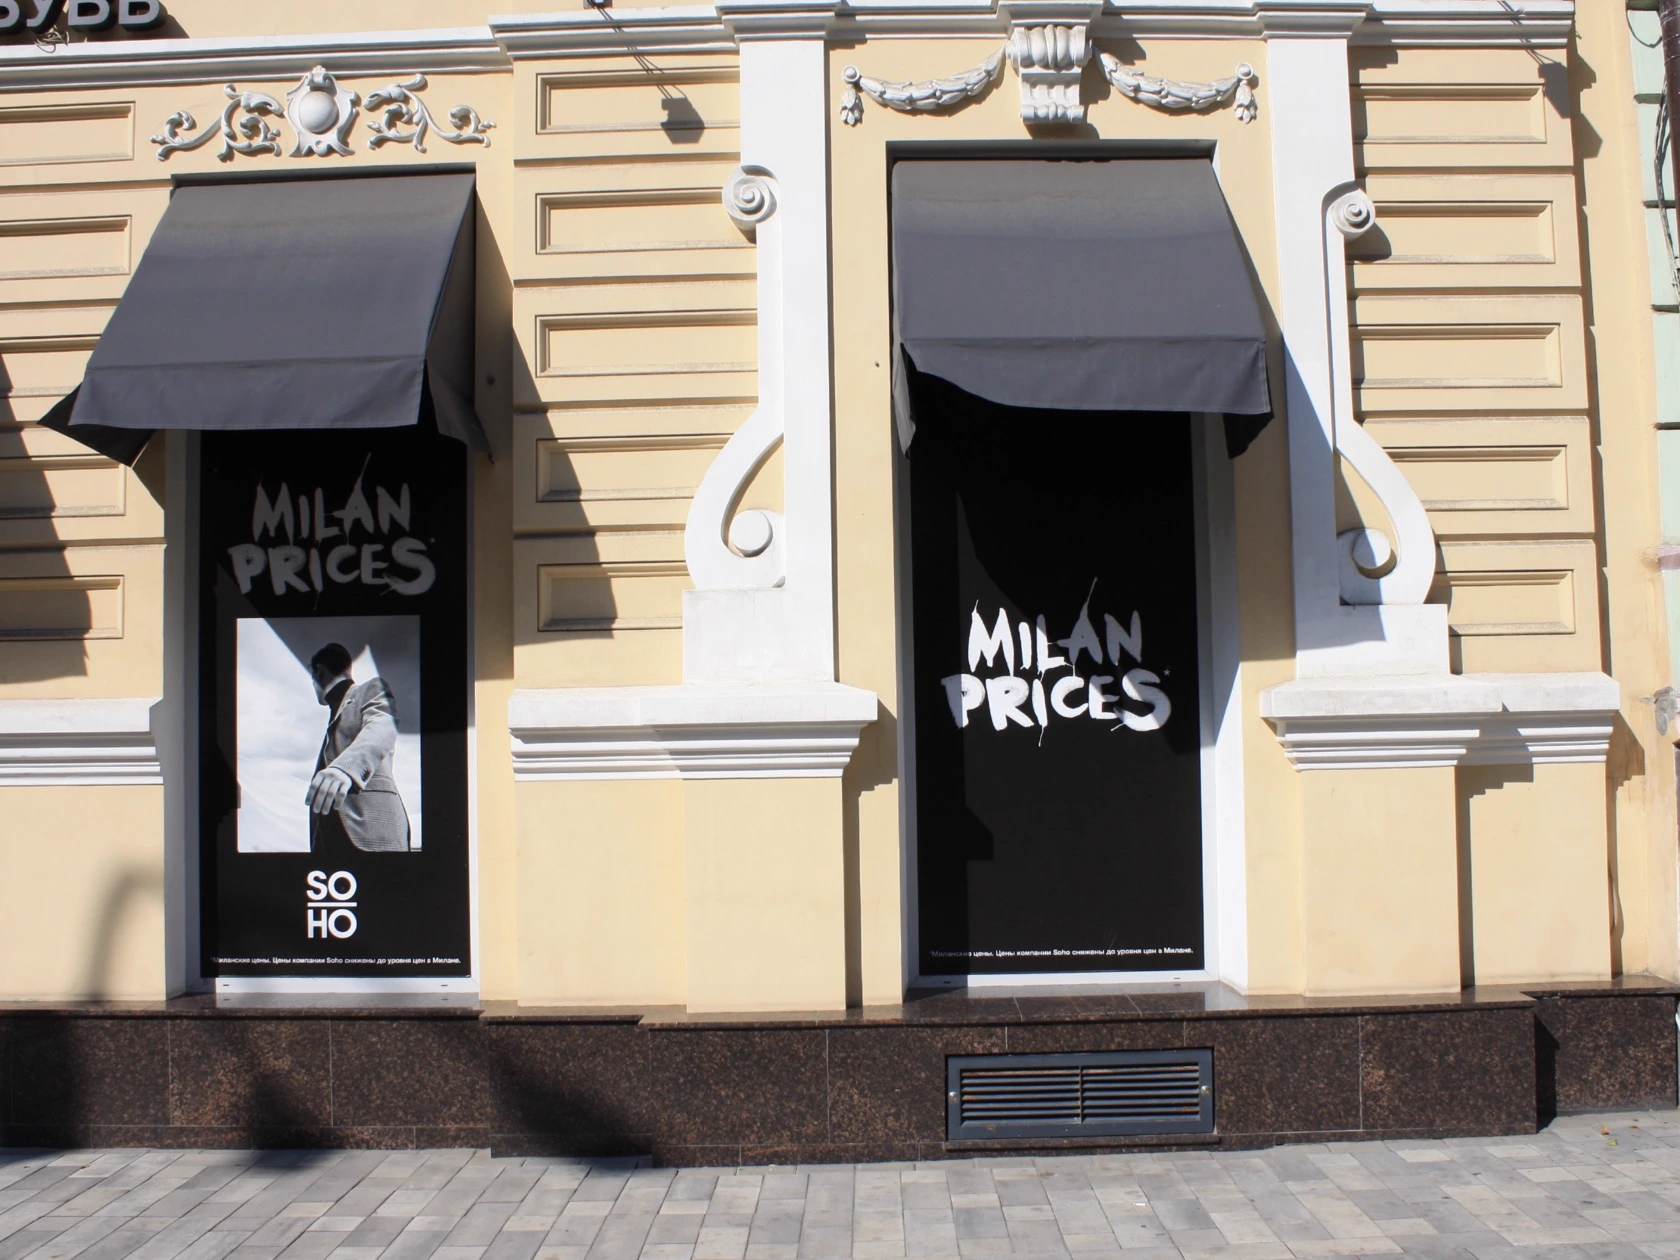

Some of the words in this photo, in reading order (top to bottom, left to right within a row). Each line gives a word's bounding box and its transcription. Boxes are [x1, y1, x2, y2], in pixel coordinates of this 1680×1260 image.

[252, 453, 412, 544] MILAN
[227, 537, 437, 598] PRICES
[968, 578, 1142, 676] MILAN
[941, 668, 1171, 738] PRICES
